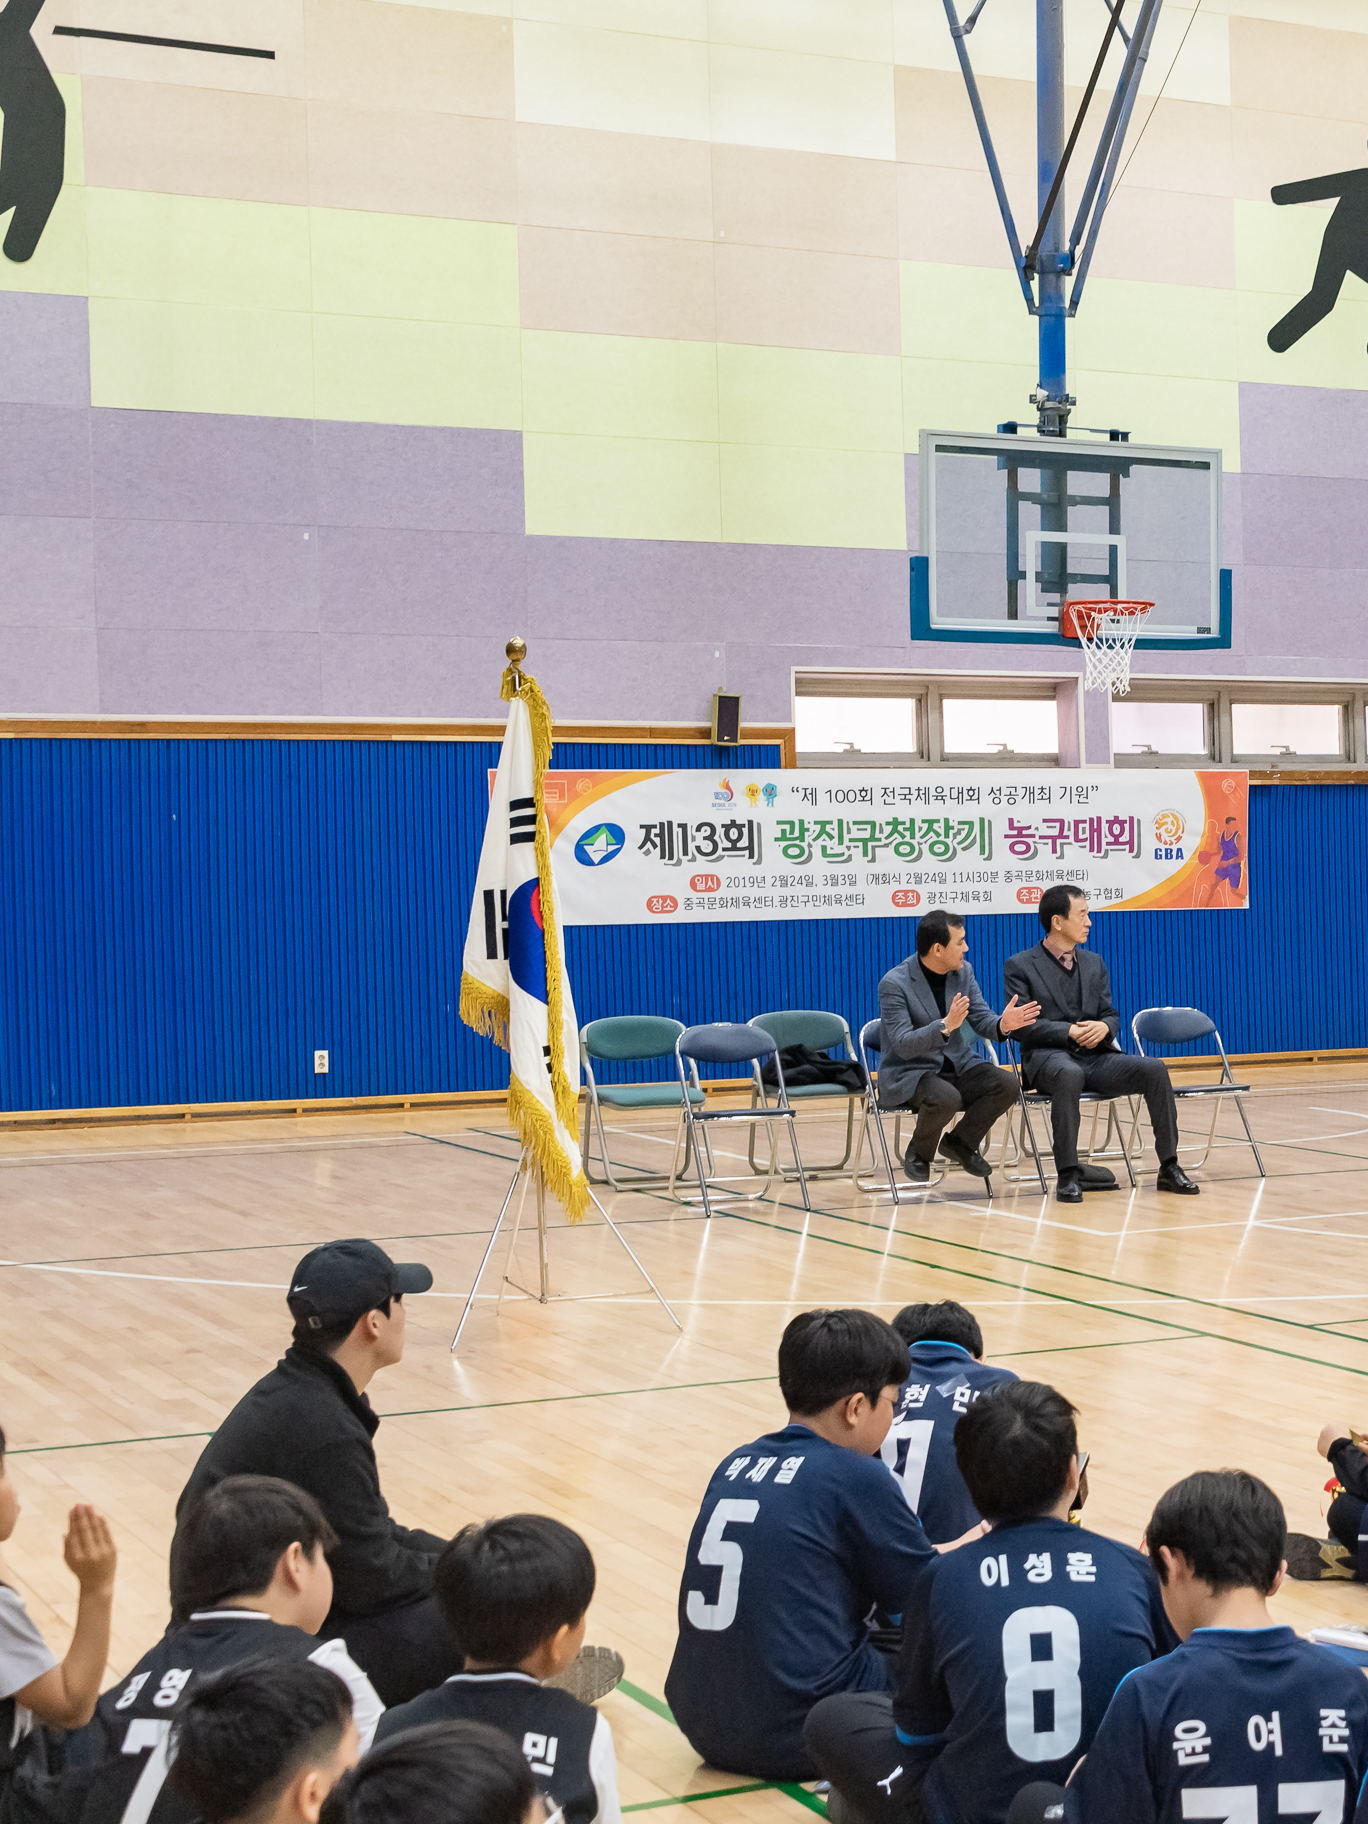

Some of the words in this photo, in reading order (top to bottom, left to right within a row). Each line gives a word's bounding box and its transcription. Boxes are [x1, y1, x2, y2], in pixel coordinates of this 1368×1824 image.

[825, 786, 873, 805] 100회
[880, 786, 981, 806] 전국체육대회
[988, 786, 1052, 805] 성공개최
[638, 820, 757, 862] 제13회
[774, 817, 986, 860] 광진구청장기
[1004, 816, 1136, 856] 농구대회
[1154, 848, 1184, 860] GBA
[694, 877, 717, 890] 일시
[725, 876, 766, 889] 2019년
[822, 873, 857, 887] 3월3일
[866, 872, 901, 886] (개회식
[905, 871, 948, 884] 2월24일
[952, 870, 1000, 884] 11시30분
[895, 894, 917, 906] 주최
[926, 891, 993, 904] 광진구체육회
[1019, 888, 1041, 902] 주관
[651, 898, 675, 912] 장소
[686, 1498, 761, 1632] 5
[1002, 1604, 1083, 1763] 8
